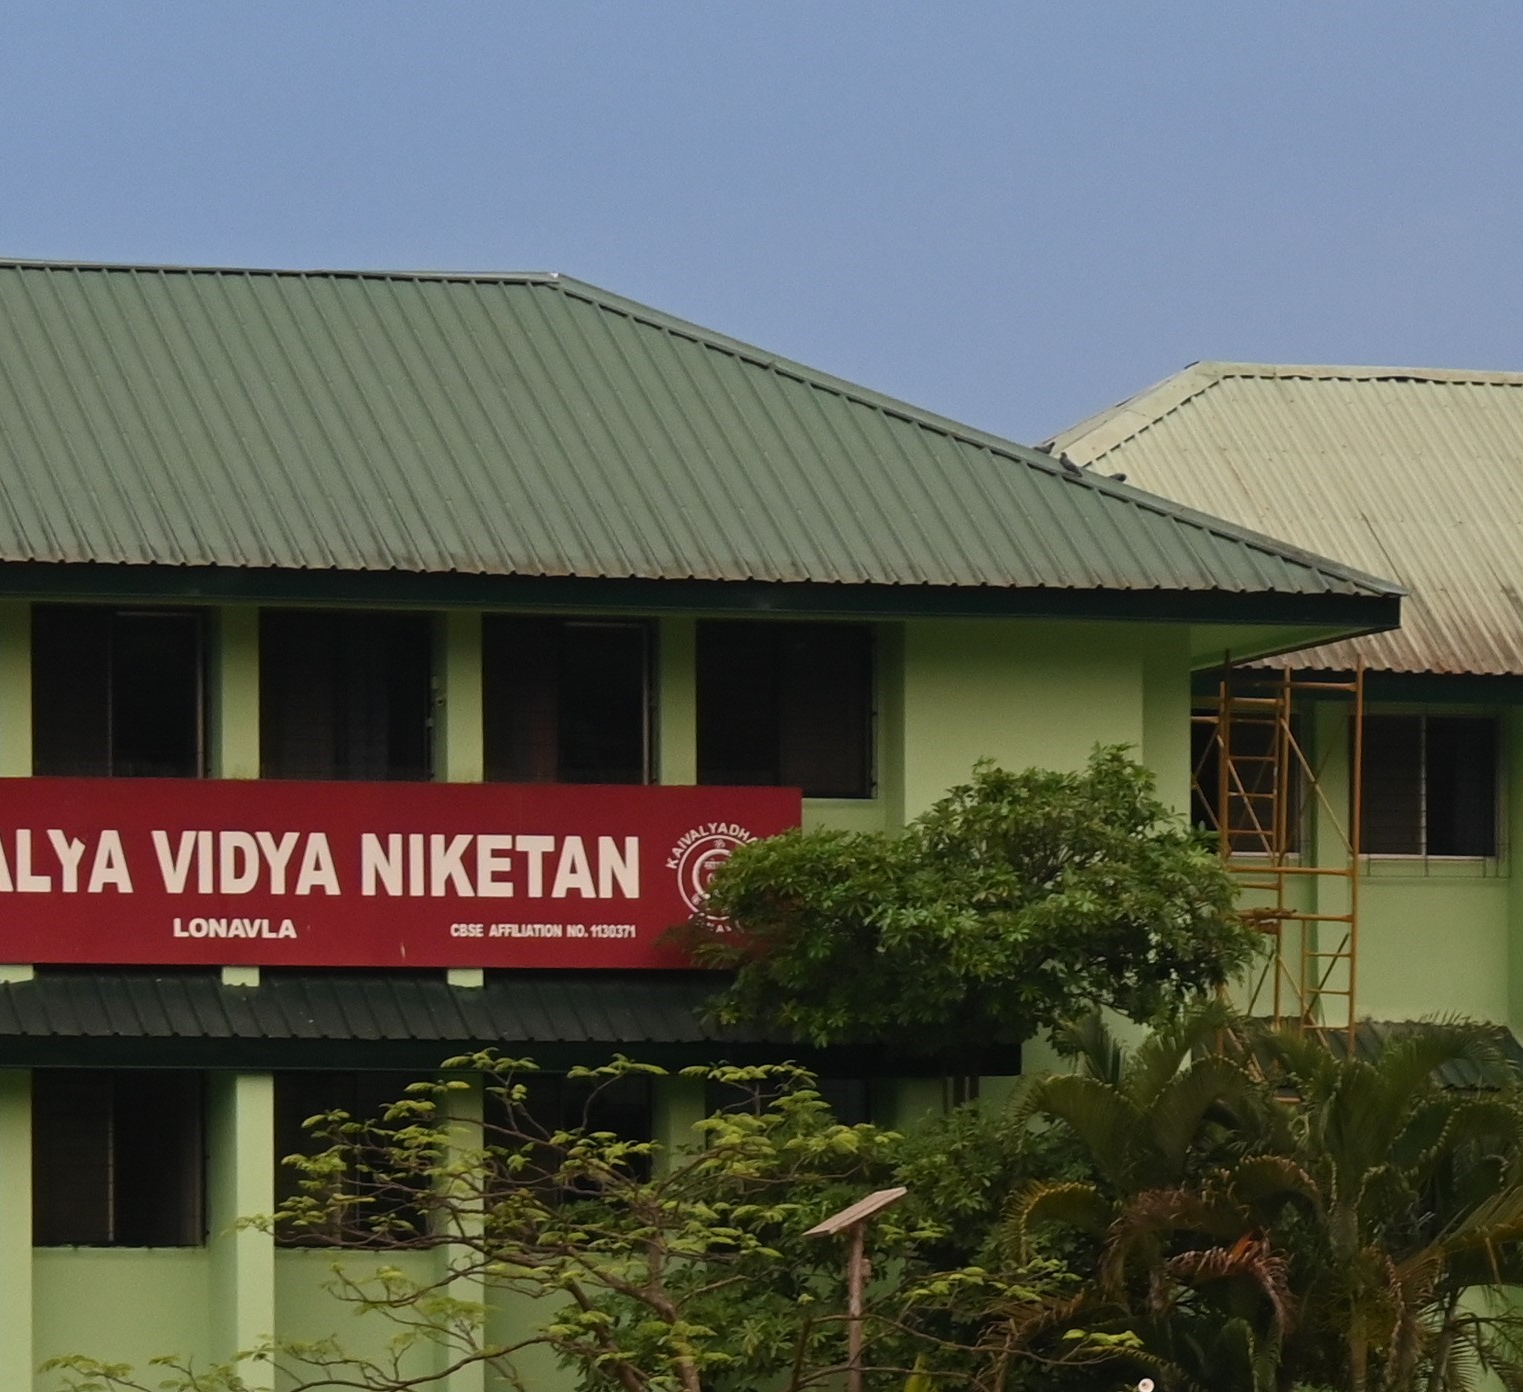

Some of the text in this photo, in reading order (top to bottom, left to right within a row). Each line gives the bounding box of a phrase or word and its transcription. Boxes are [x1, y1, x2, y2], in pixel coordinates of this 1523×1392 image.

[151, 830, 342, 896] VIDYA
[361, 832, 640, 899] NIKETAN
[173, 917, 298, 939] LONAVLA
[450, 923, 636, 939] CBSE AFFILIATION NO. 1130371
